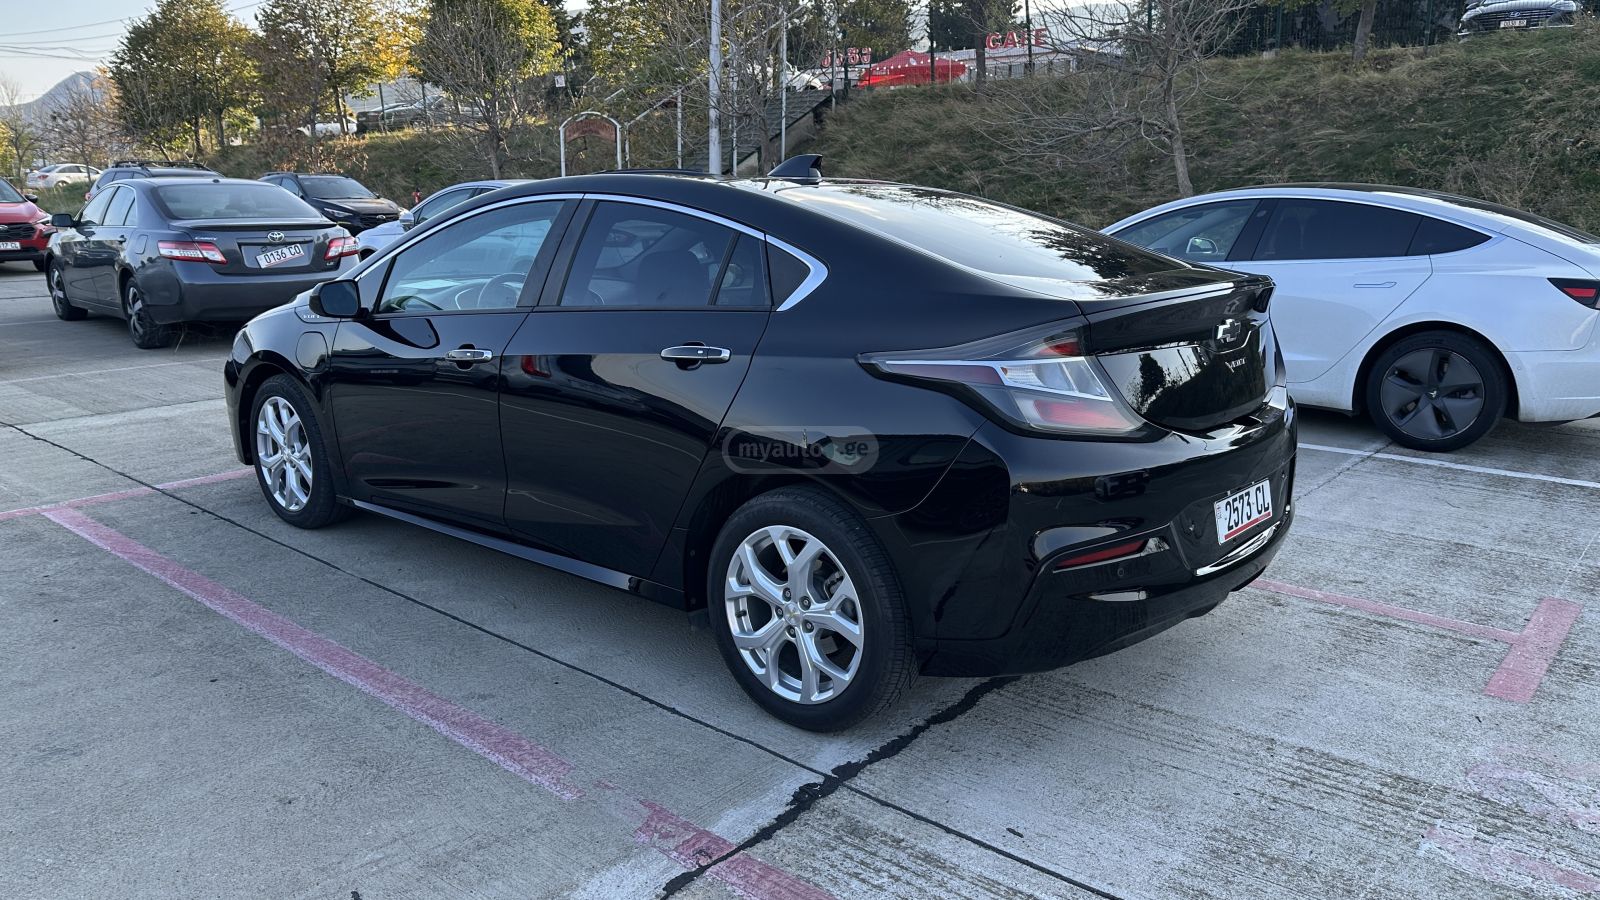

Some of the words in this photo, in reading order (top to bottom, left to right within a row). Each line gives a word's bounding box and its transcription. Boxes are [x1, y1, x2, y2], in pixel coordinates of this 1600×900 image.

[263, 249, 287, 264] 0136
[1225, 490, 1252, 532] 2573
[1255, 484, 1270, 515] CL
